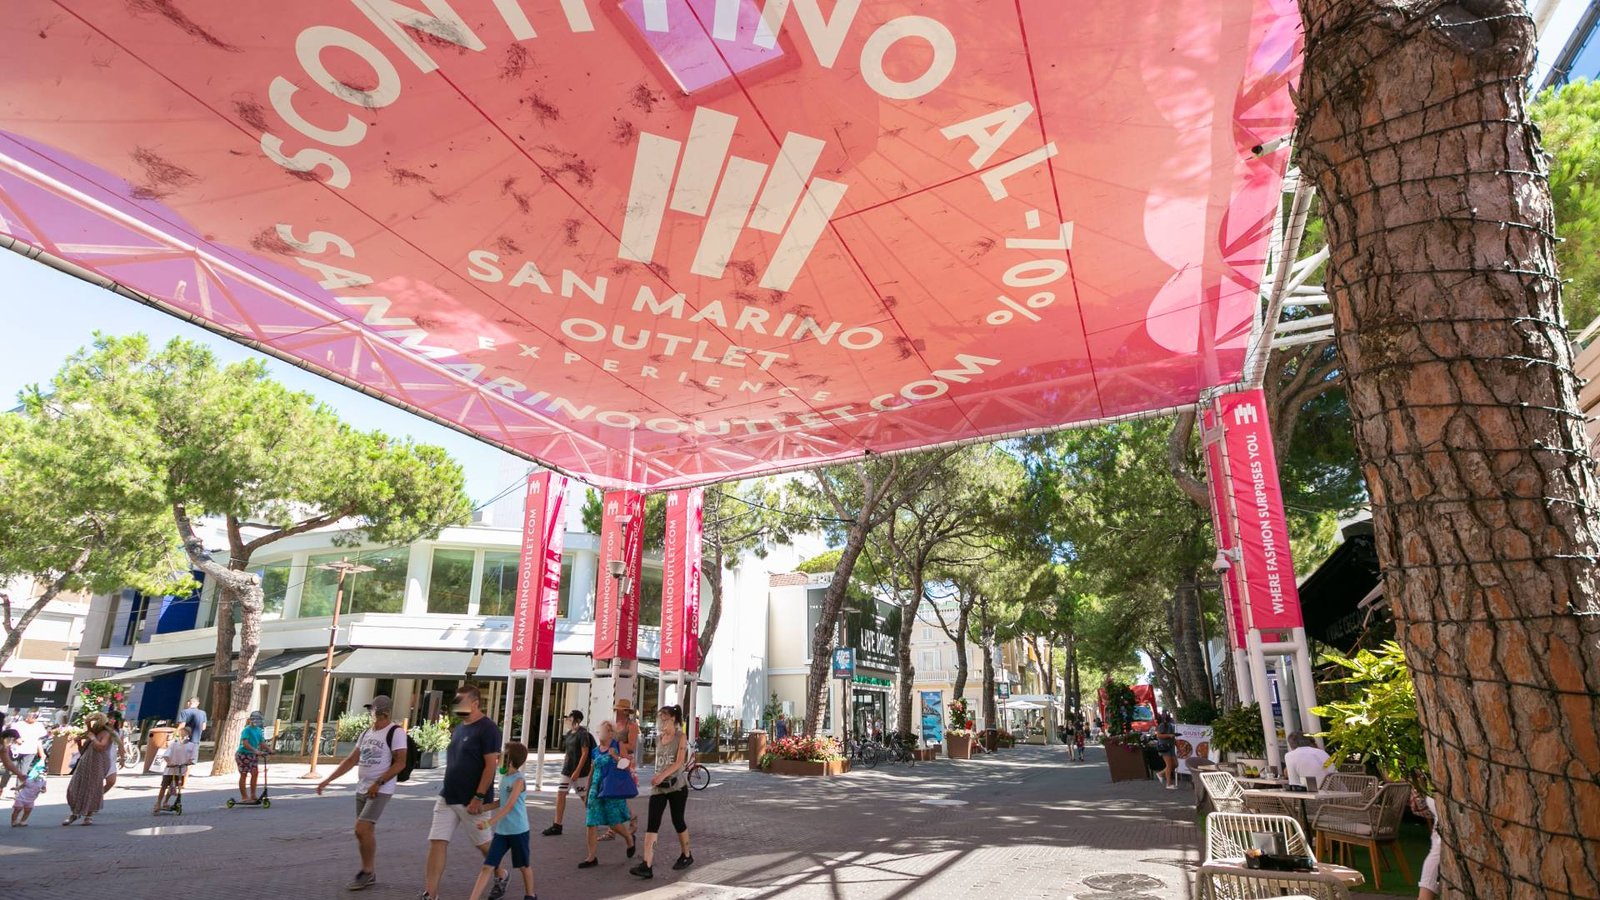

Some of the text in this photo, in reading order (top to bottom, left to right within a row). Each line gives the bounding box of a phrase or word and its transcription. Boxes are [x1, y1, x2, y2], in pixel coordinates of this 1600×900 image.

[939, 101, 1059, 202] AL
[467, 249, 884, 351] SAN MARINO
[985, 209, 1075, 326] -70%
[275, 223, 1003, 439] SANMARINOOUTLET.COM
[477, 335, 834, 404] EXPERIENCE
[560, 317, 789, 373] OUTLET
[515, 508, 538, 652] SANMARINOOUTLET.COM
[1245, 432, 1286, 615] WHERE FASHION SURPRISES YOU.
[665, 520, 677, 655] SANMARINOOUTLET.COM
